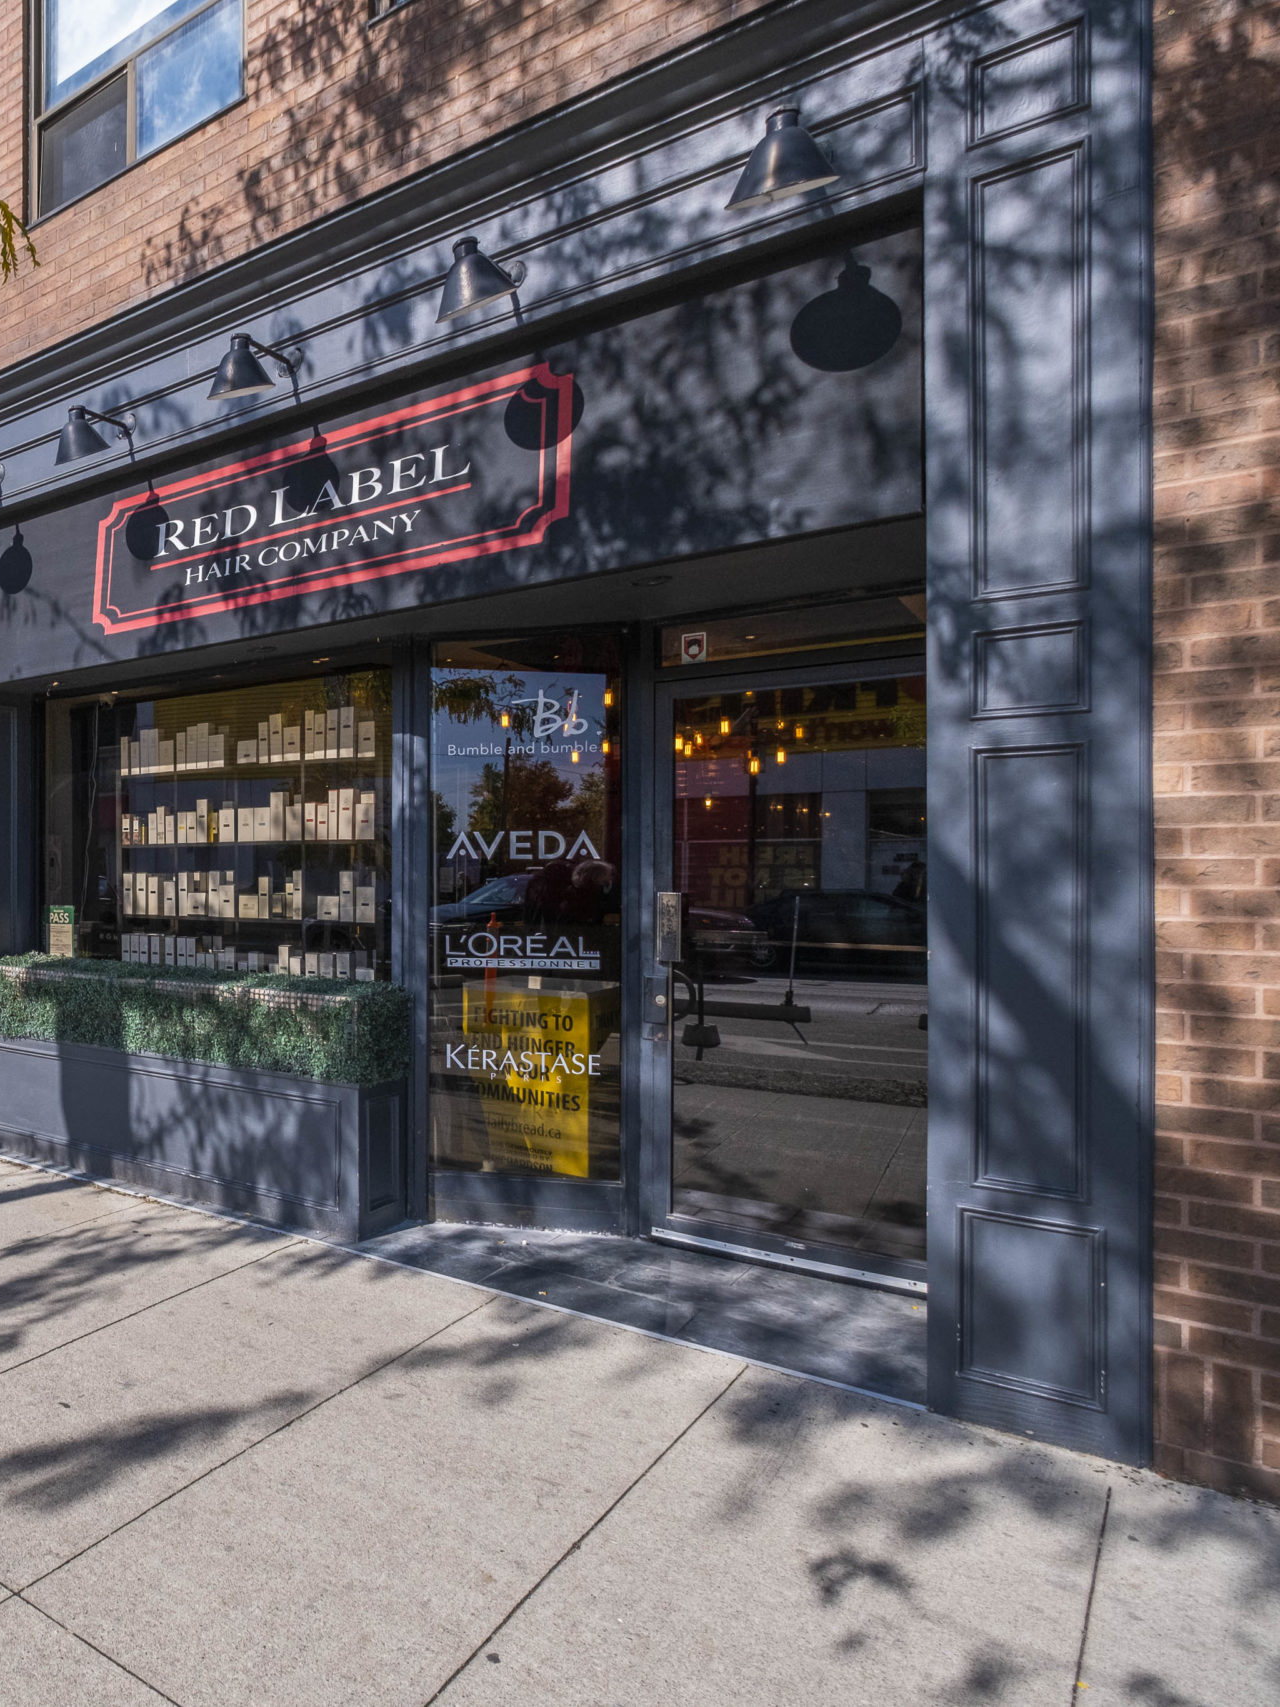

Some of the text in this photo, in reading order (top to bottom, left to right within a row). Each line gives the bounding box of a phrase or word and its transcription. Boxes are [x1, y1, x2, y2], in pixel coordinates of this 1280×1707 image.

[152, 444, 472, 558] RED LABEL
[184, 509, 422, 586] HAIR COMPANY
[447, 743, 503, 757] Bumble
[507, 742, 535, 755] and
[446, 829, 601, 861] AVEDA
[49, 912, 69, 924] PASS
[449, 958, 598, 969] PROFESSIONNEL
[552, 1013, 573, 1032] TO
[445, 1043, 601, 1076] KÉRASTASE
[477, 1082, 581, 1112] OMMUNITIES
